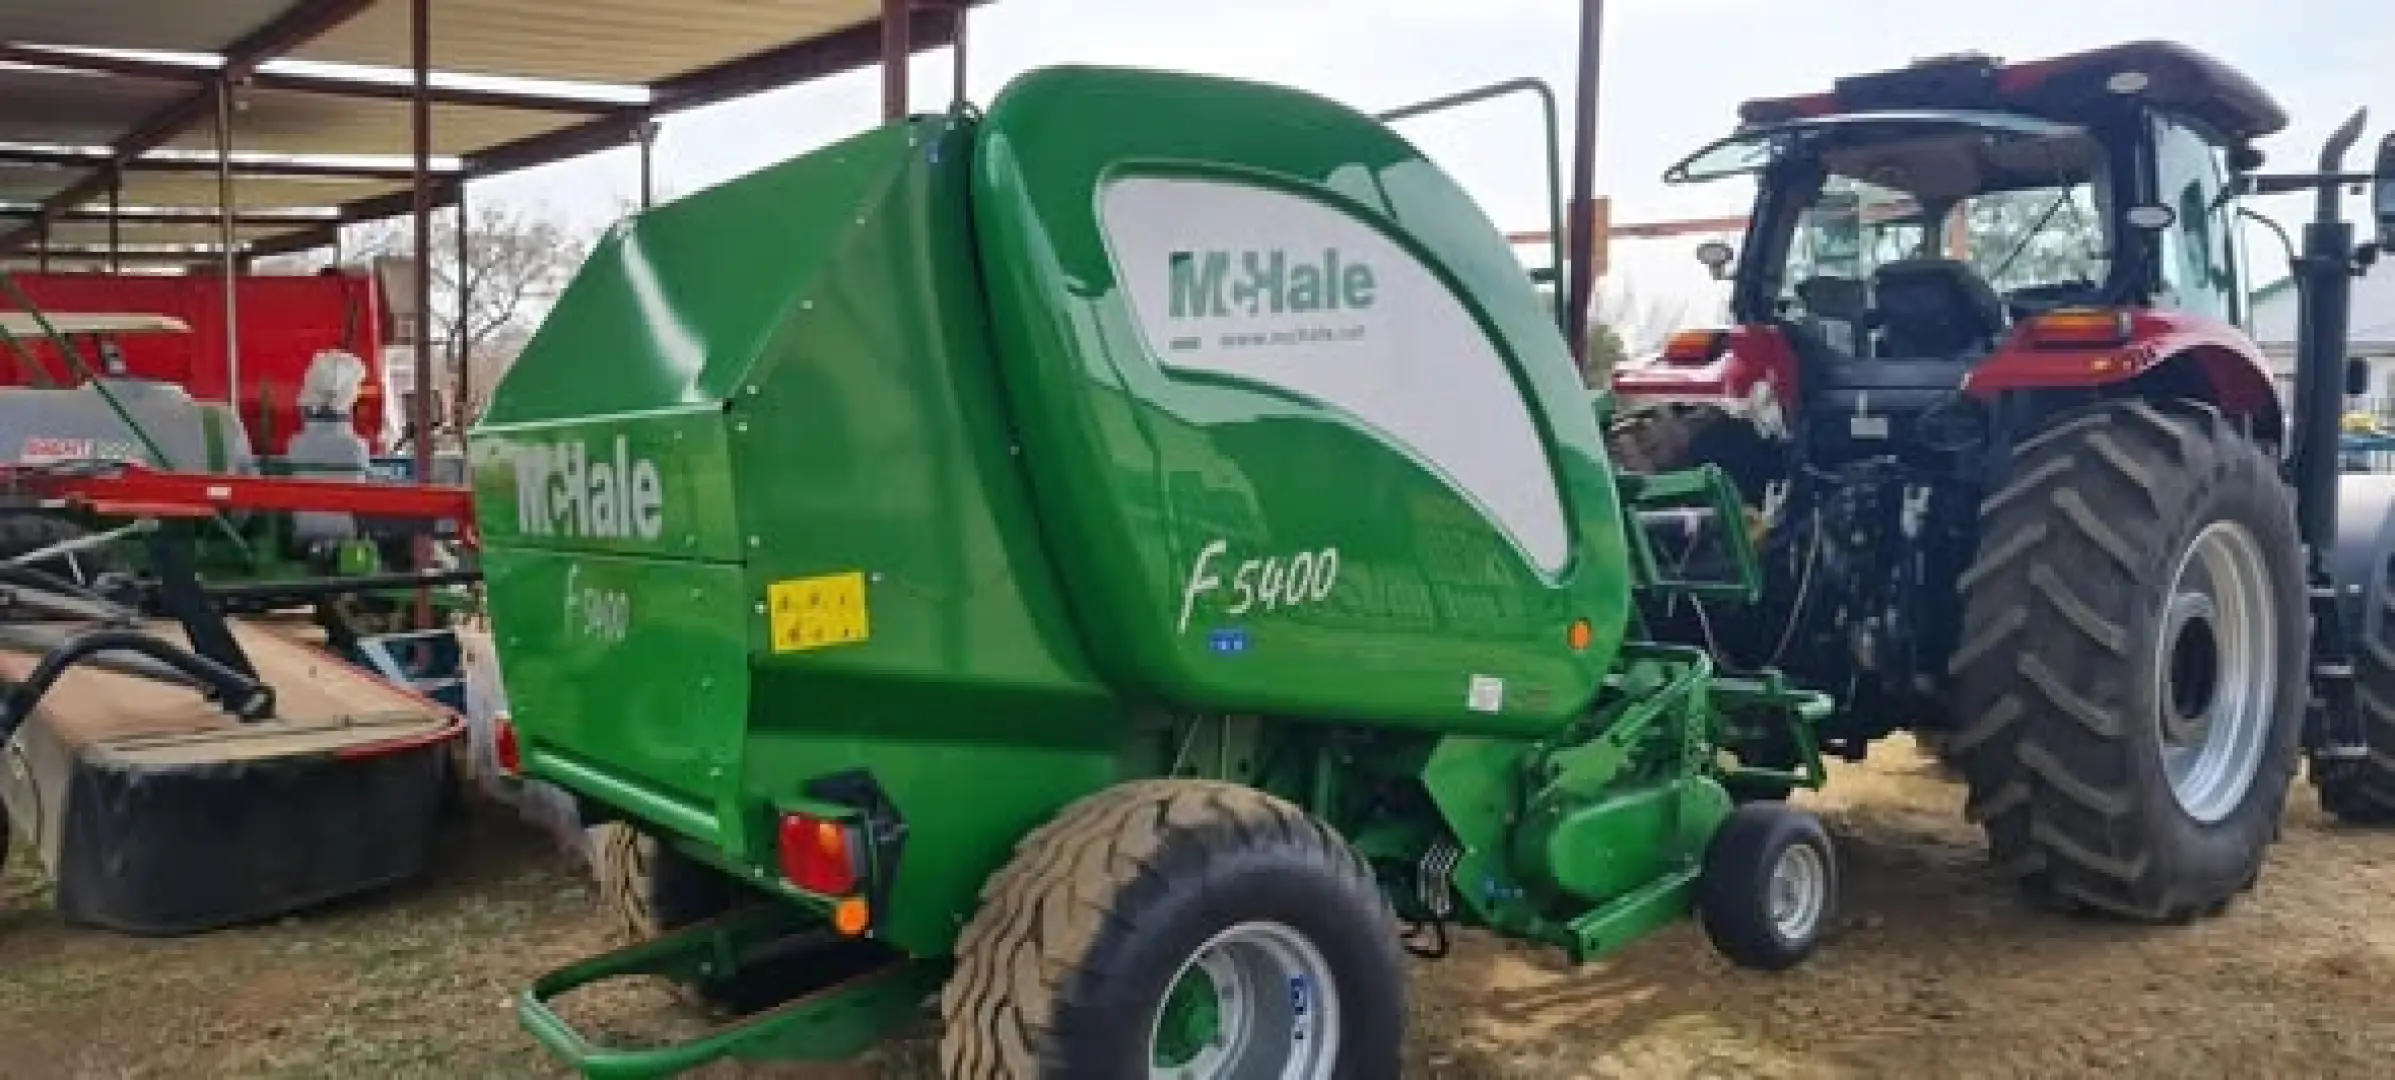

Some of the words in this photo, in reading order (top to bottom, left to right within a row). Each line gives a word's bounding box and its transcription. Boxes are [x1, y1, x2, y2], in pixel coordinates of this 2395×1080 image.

[1168, 247, 1376, 318] McHale
[515, 434, 662, 540] McHale
[1227, 547, 1338, 615] 5400
